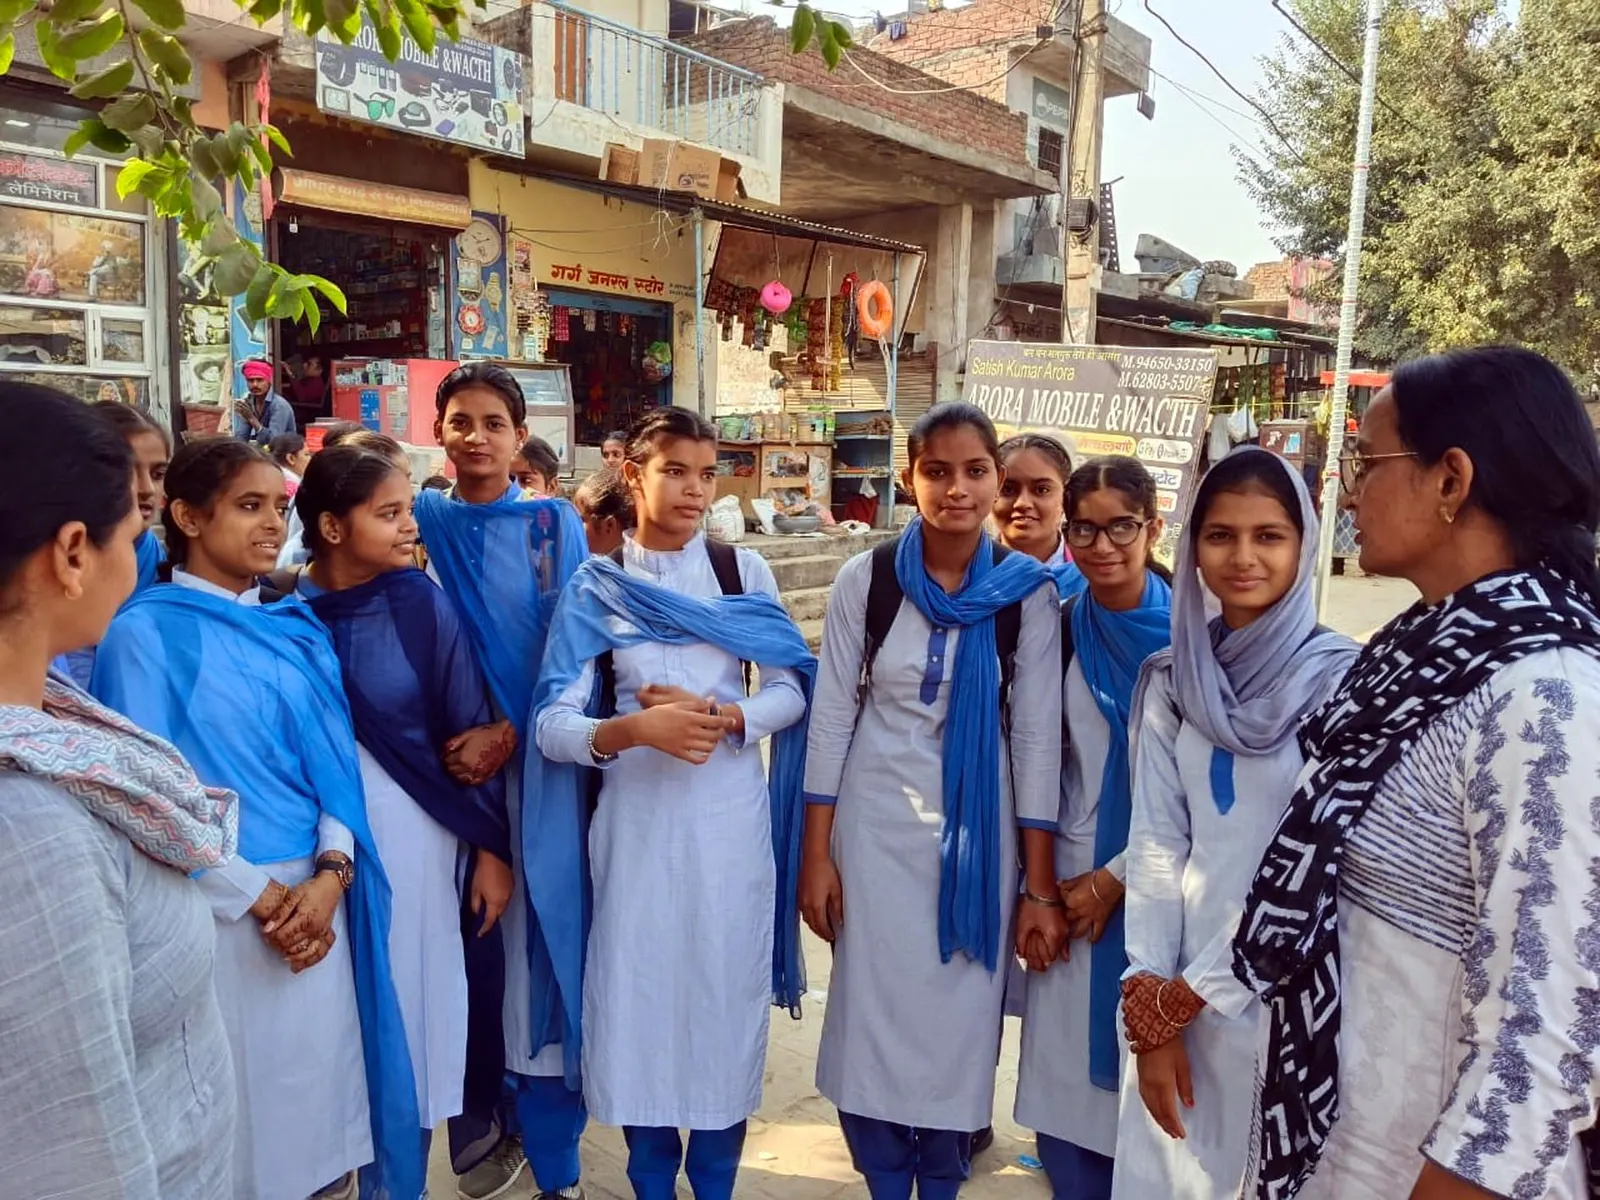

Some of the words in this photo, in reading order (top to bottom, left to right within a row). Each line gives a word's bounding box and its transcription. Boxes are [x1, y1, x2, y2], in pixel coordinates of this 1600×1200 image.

[443, 48, 492, 83] &WACTH
[551, 263, 582, 283] गर्ग
[587, 270, 629, 290] जनरल
[634, 274, 665, 297] स्टोर
[972, 357, 1003, 376] Satish
[1006, 359, 1043, 378] Kumar
[1044, 362, 1075, 380] Arora
[1121, 355, 1213, 372] M.94650-33150
[1118, 371, 1206, 391] M.62803-5507
[1027, 389, 1104, 429] MOBILE
[1106, 394, 1198, 437] &WACTH
